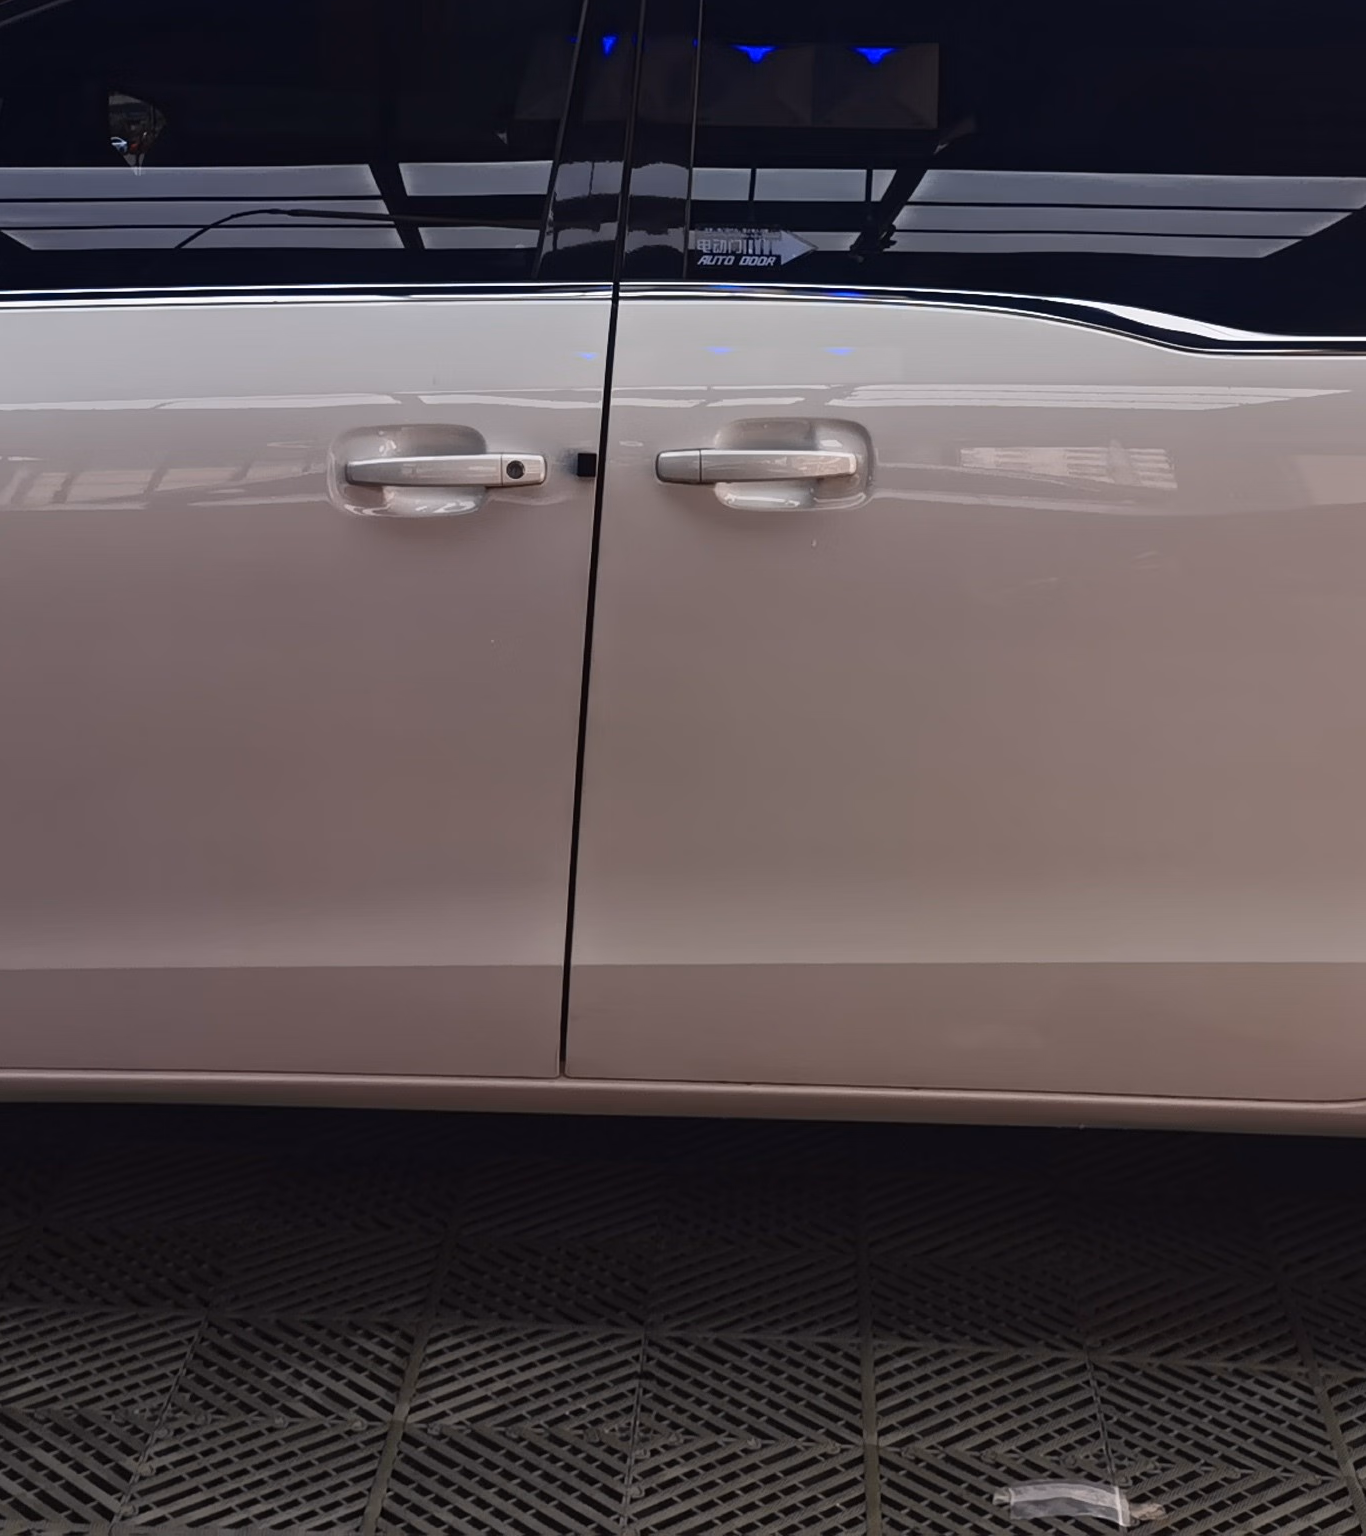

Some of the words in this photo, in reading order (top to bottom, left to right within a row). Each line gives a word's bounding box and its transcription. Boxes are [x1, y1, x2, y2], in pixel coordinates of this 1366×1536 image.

[696, 238, 742, 254] 电动门
[696, 255, 735, 265] AUTO
[738, 256, 776, 266] DOOR
